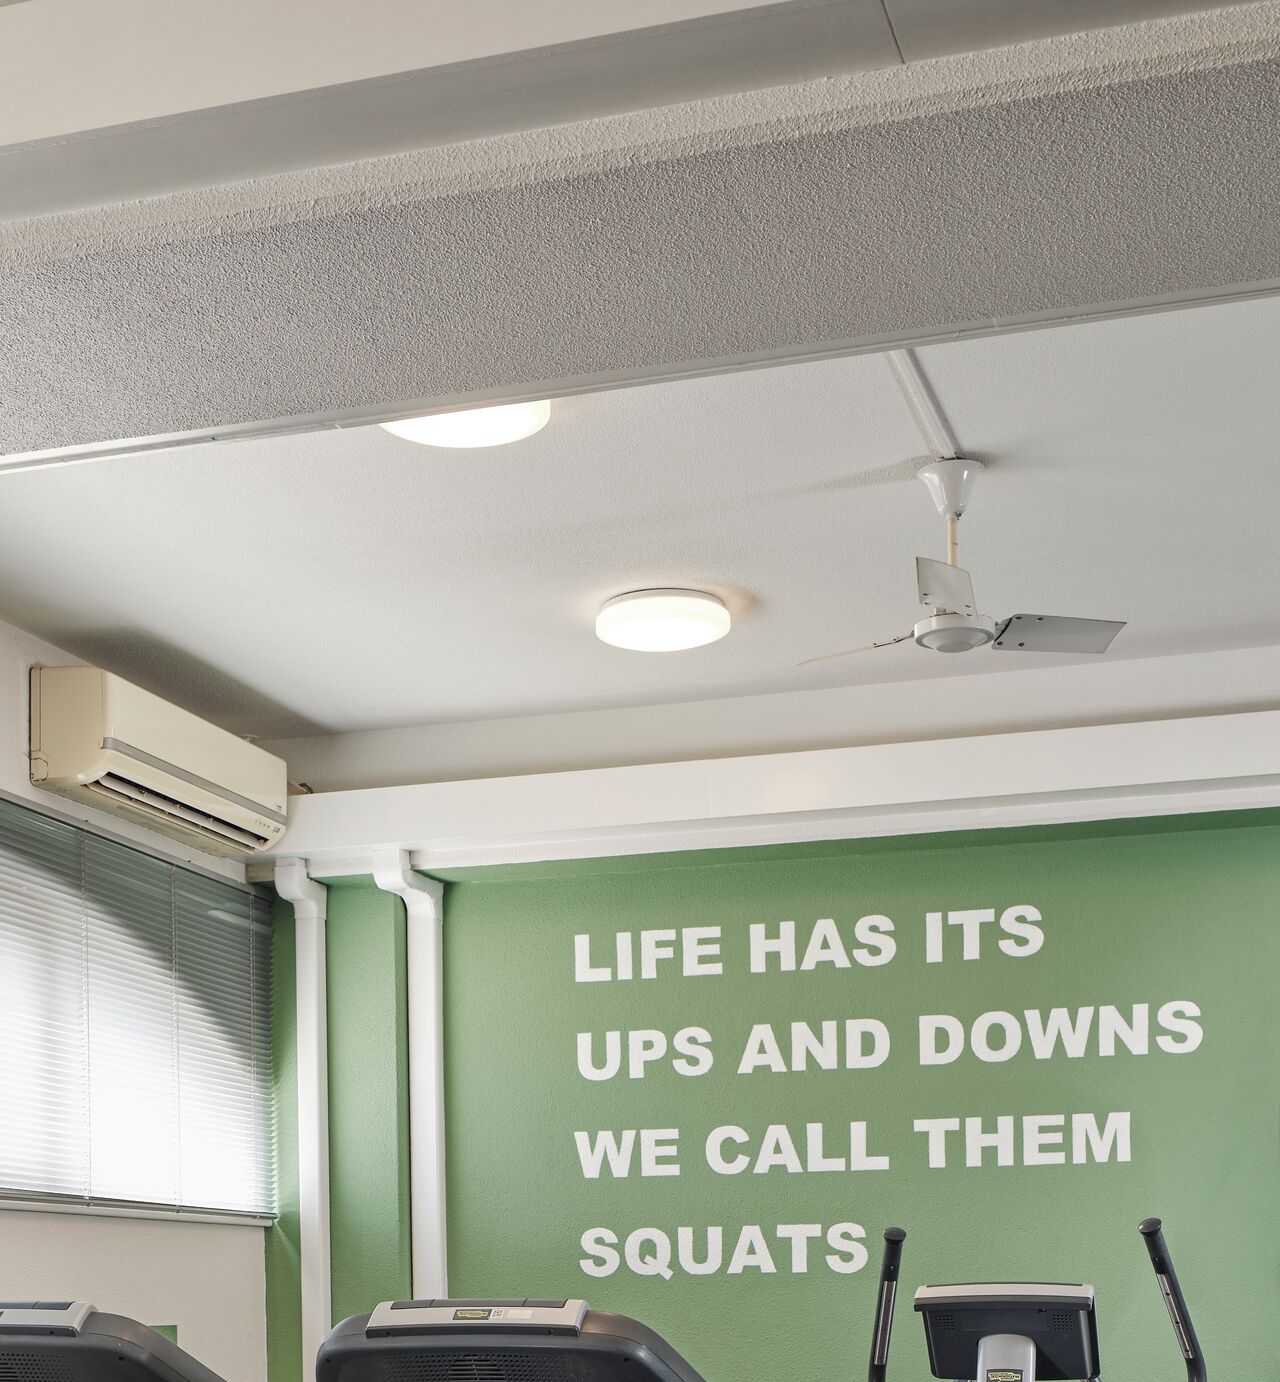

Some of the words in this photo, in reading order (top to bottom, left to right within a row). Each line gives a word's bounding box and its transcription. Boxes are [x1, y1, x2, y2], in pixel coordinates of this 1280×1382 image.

[573, 927, 723, 983] LIFE
[750, 915, 896, 973] HAS
[926, 905, 1044, 963] ITS
[576, 1027, 714, 1084] UPS
[737, 1019, 890, 1074] AND
[919, 1000, 1203, 1065] DOWNS
[574, 1128, 680, 1178] WE
[705, 1121, 889, 1174] CALL
[914, 1112, 1131, 1168] THEM
[580, 1223, 868, 1280] SQUATS
